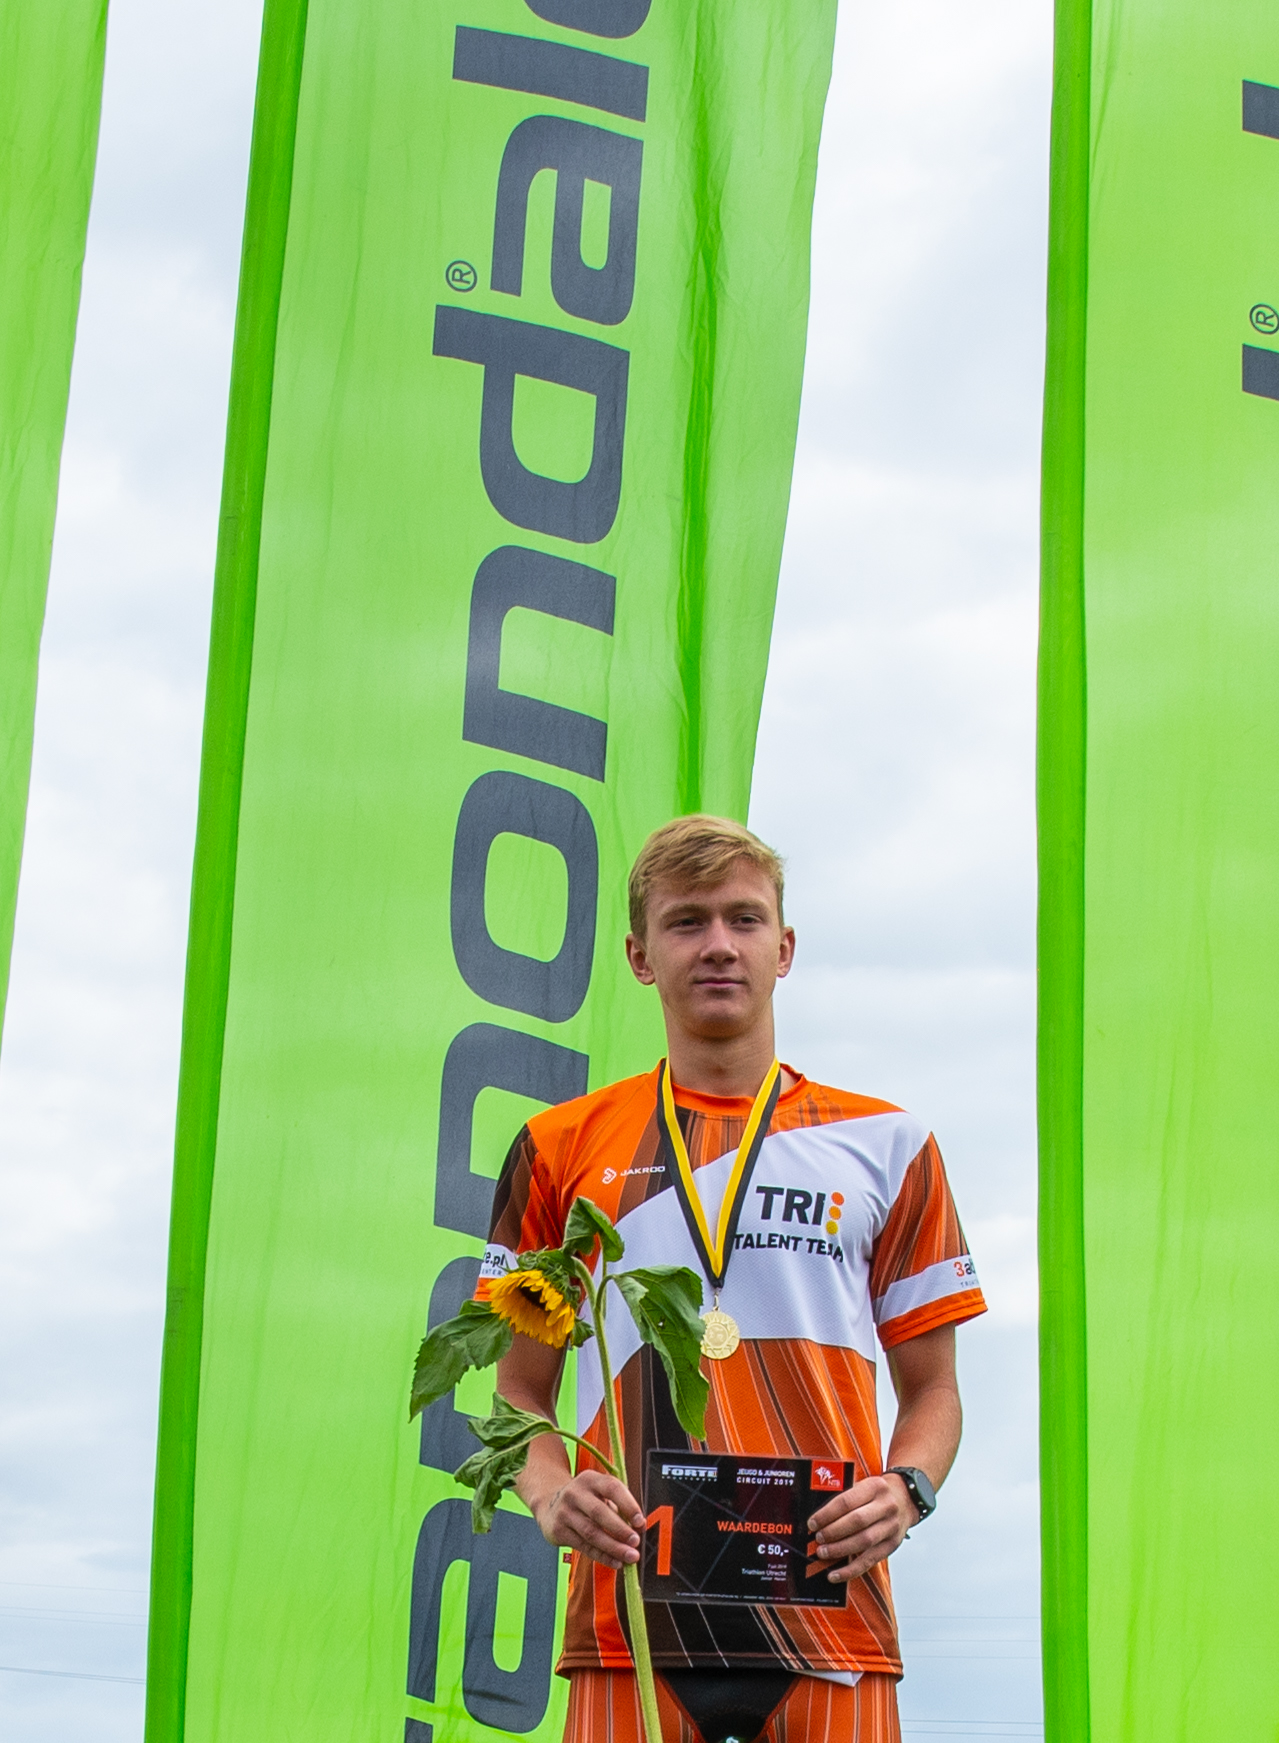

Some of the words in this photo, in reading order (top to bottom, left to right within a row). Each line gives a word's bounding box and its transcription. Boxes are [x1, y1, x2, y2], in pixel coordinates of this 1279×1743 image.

[755, 1185, 827, 1226] TRI
[733, 1232, 803, 1252] TALENT
[662, 1464, 718, 1478] FORTE
[736, 1476, 771, 1485] CIRCUIT
[773, 1478, 794, 1486] 2019
[717, 1521, 793, 1536] WAARDEBON
[646, 1505, 674, 1576] 1
[757, 1543, 766, 1555] €
[767, 1544, 789, 1557] 50,-
